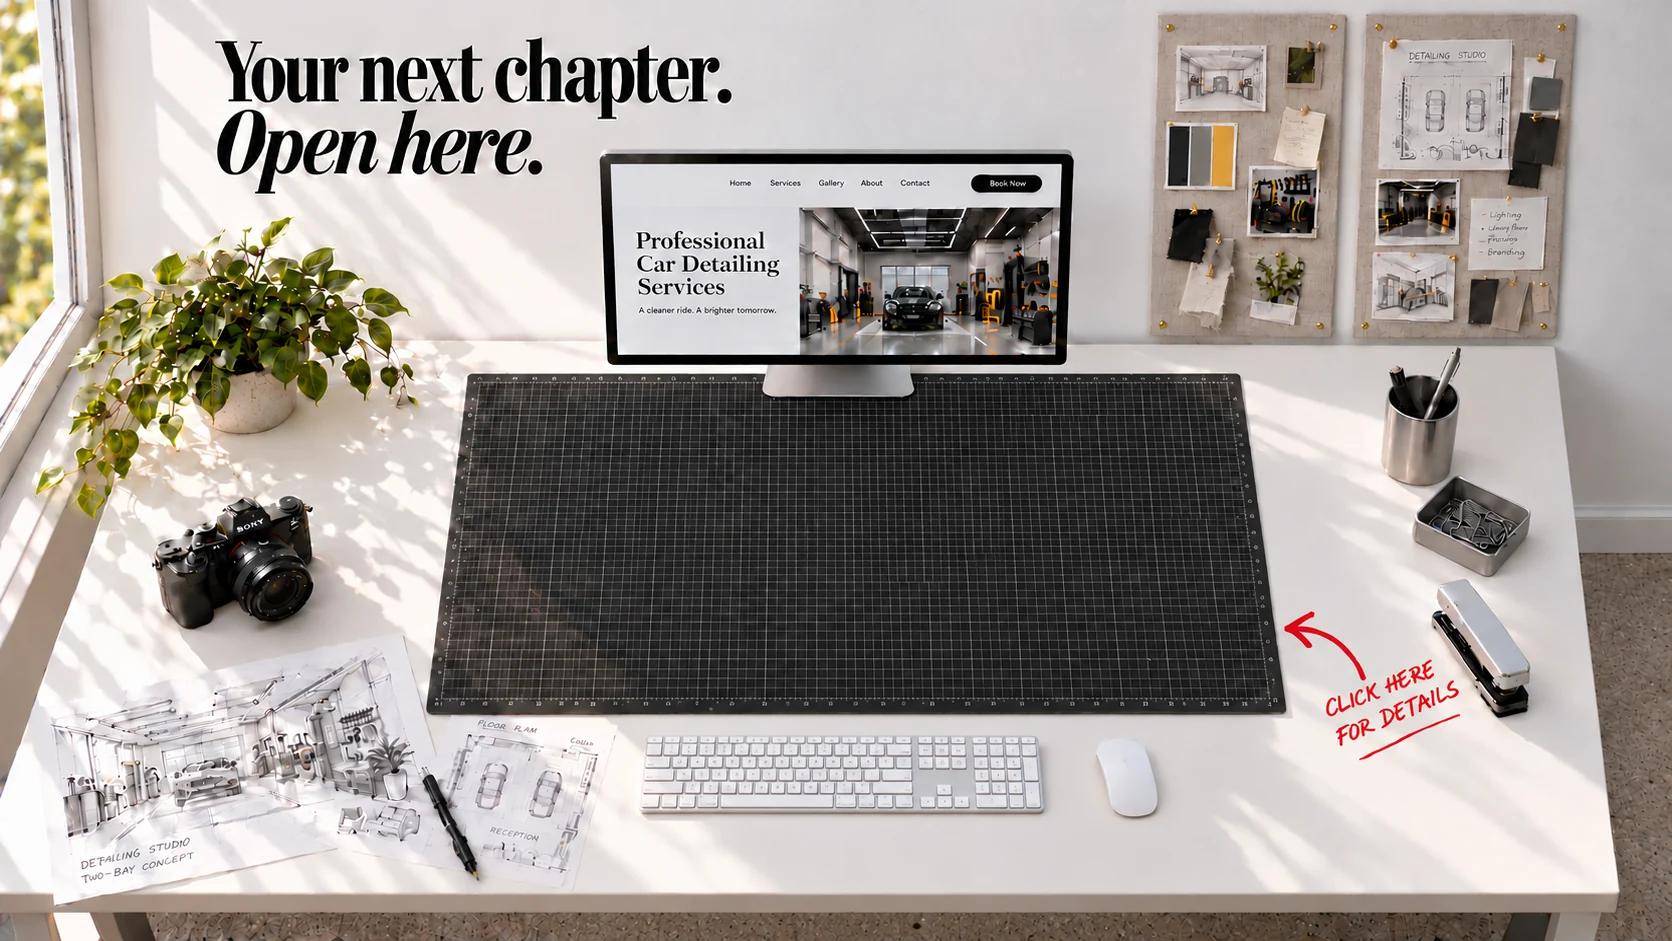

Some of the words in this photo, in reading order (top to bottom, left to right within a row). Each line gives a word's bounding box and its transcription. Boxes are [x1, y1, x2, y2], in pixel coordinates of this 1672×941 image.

[1409, 52, 1451, 60] DETAILING
[1458, 51, 1487, 60] STUDIO
[729, 179, 752, 187] Home
[770, 179, 801, 187] Services
[818, 179, 845, 189] Gallery
[860, 179, 883, 187] About
[900, 179, 931, 187] Contact
[989, 179, 1009, 187] Book
[1010, 179, 1027, 187] Now
[1490, 211, 1522, 221] Lighting
[636, 231, 765, 249] Professional
[637, 255, 676, 273] Car
[681, 254, 780, 277] Detailing
[638, 277, 725, 296] Services
[638, 306, 645, 314] A
[646, 306, 674, 314] cleaner
[676, 306, 694, 314] ride.
[696, 306, 702, 314] A
[704, 306, 735, 316] brighter
[737, 306, 777, 314] tomorrow.
[489, 826, 540, 841] RECEPTION
[81, 848, 141, 870] DETAILING
[149, 837, 191, 854] STUDIO
[81, 865, 136, 884] TWO-BAY
[142, 852, 195, 871] CONCEPT
